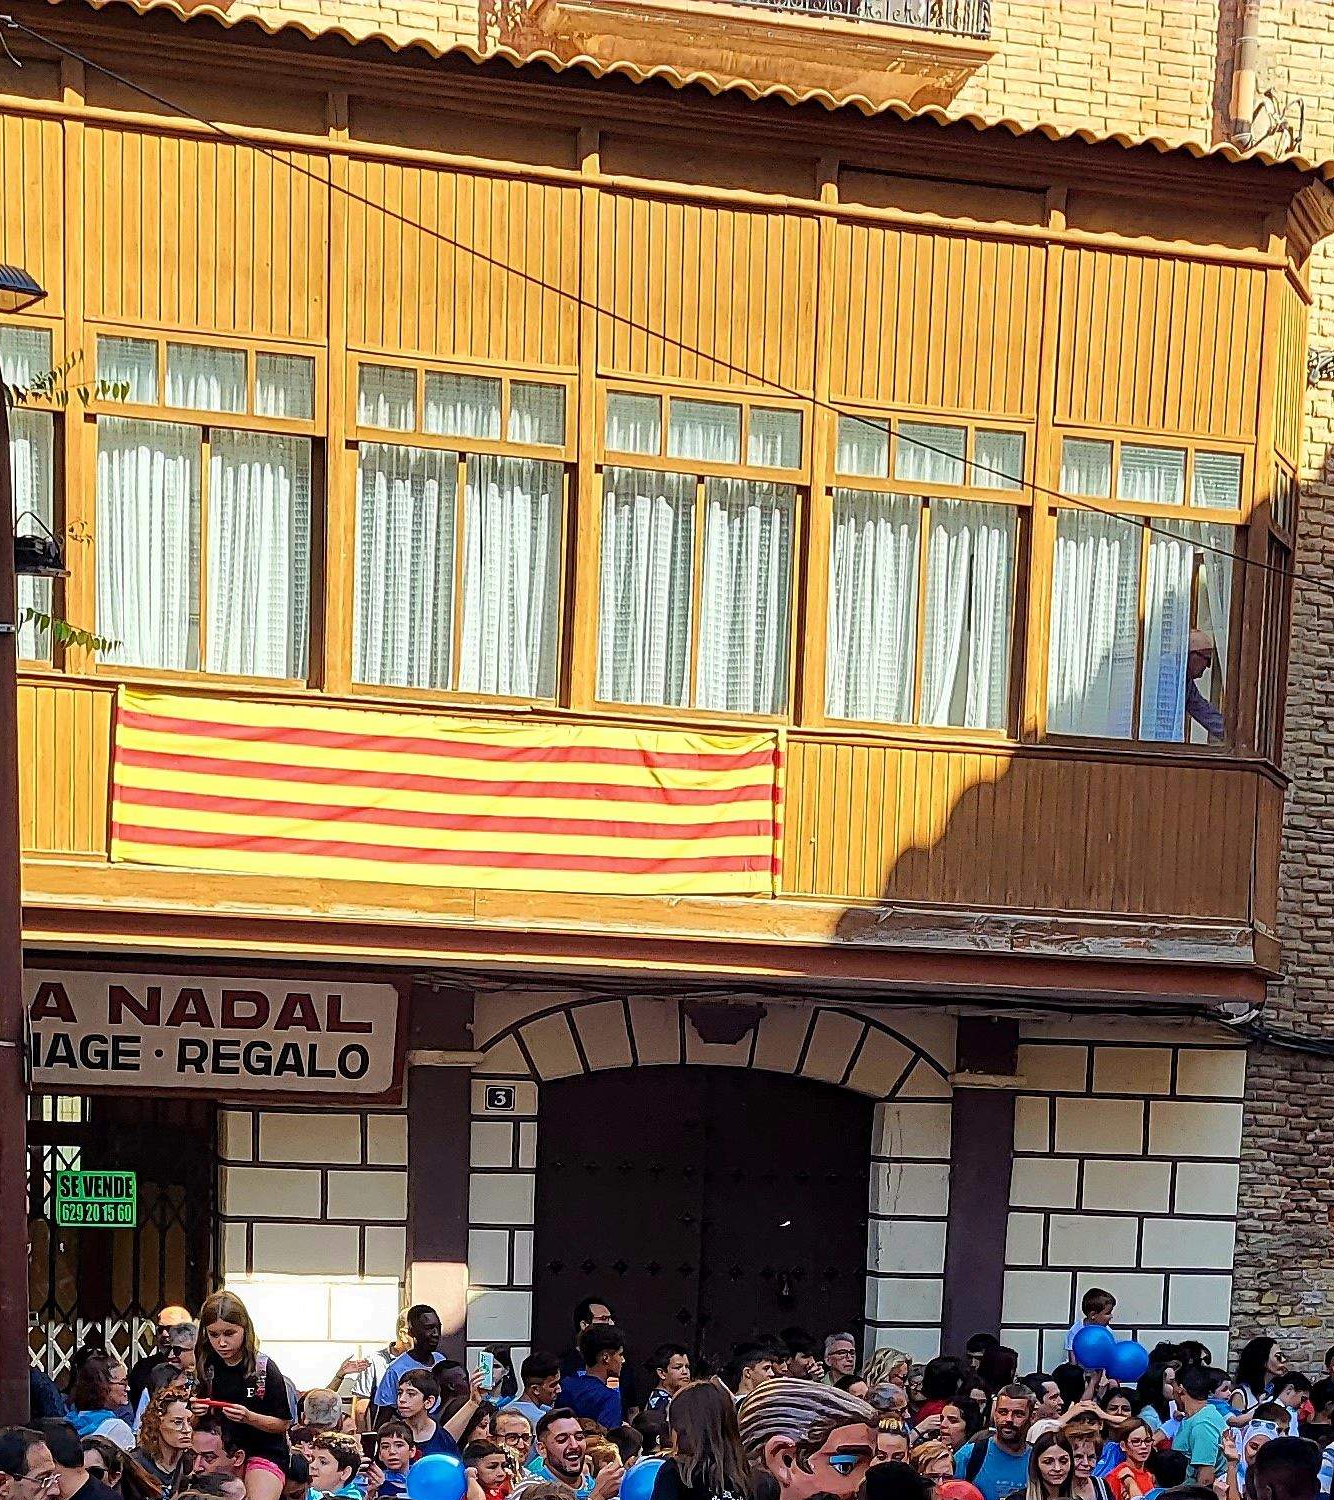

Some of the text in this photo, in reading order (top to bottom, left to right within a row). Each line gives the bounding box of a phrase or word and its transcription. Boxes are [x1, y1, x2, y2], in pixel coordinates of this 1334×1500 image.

[108, 984, 373, 1034] NADAL
[177, 1037, 370, 1080] REGALO
[495, 1091, 506, 1105] 3
[60, 1175, 133, 1199] SE VENDE
[62, 1203, 131, 1222] 629 20 15 60
